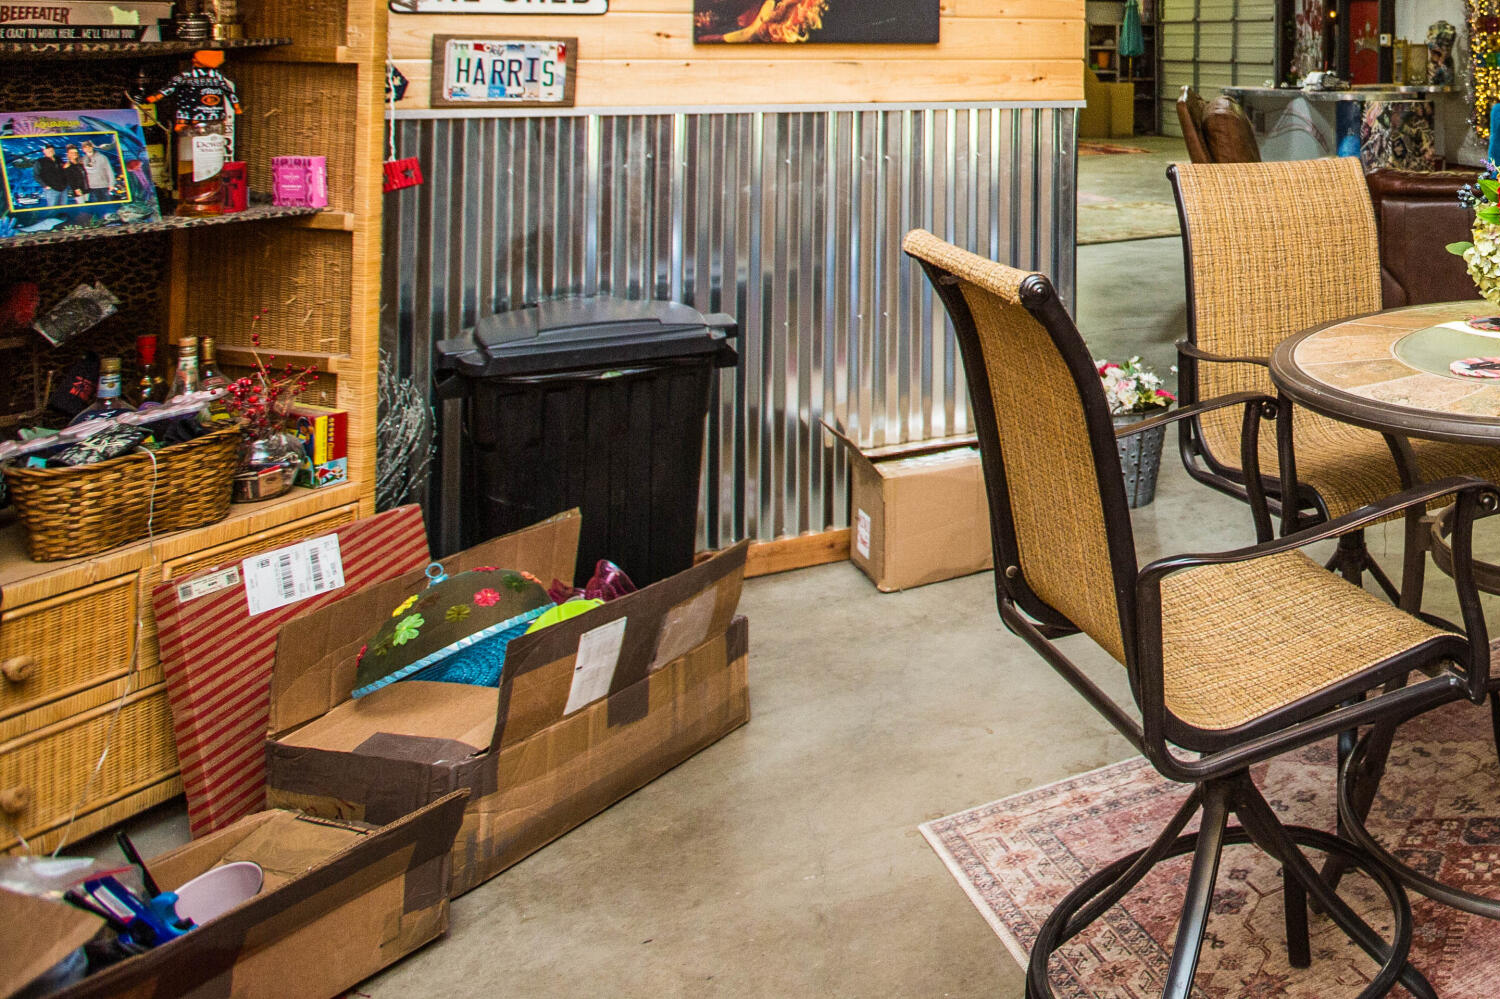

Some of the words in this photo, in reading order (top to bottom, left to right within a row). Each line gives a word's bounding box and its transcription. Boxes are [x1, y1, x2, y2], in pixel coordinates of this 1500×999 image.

[0, 5, 70, 24] BEEFEATER
[6, 28, 26, 38] CRAZY
[28, 28, 37, 38] TO
[38, 28, 58, 38] WORK
[456, 57, 554, 87] HARRIS
